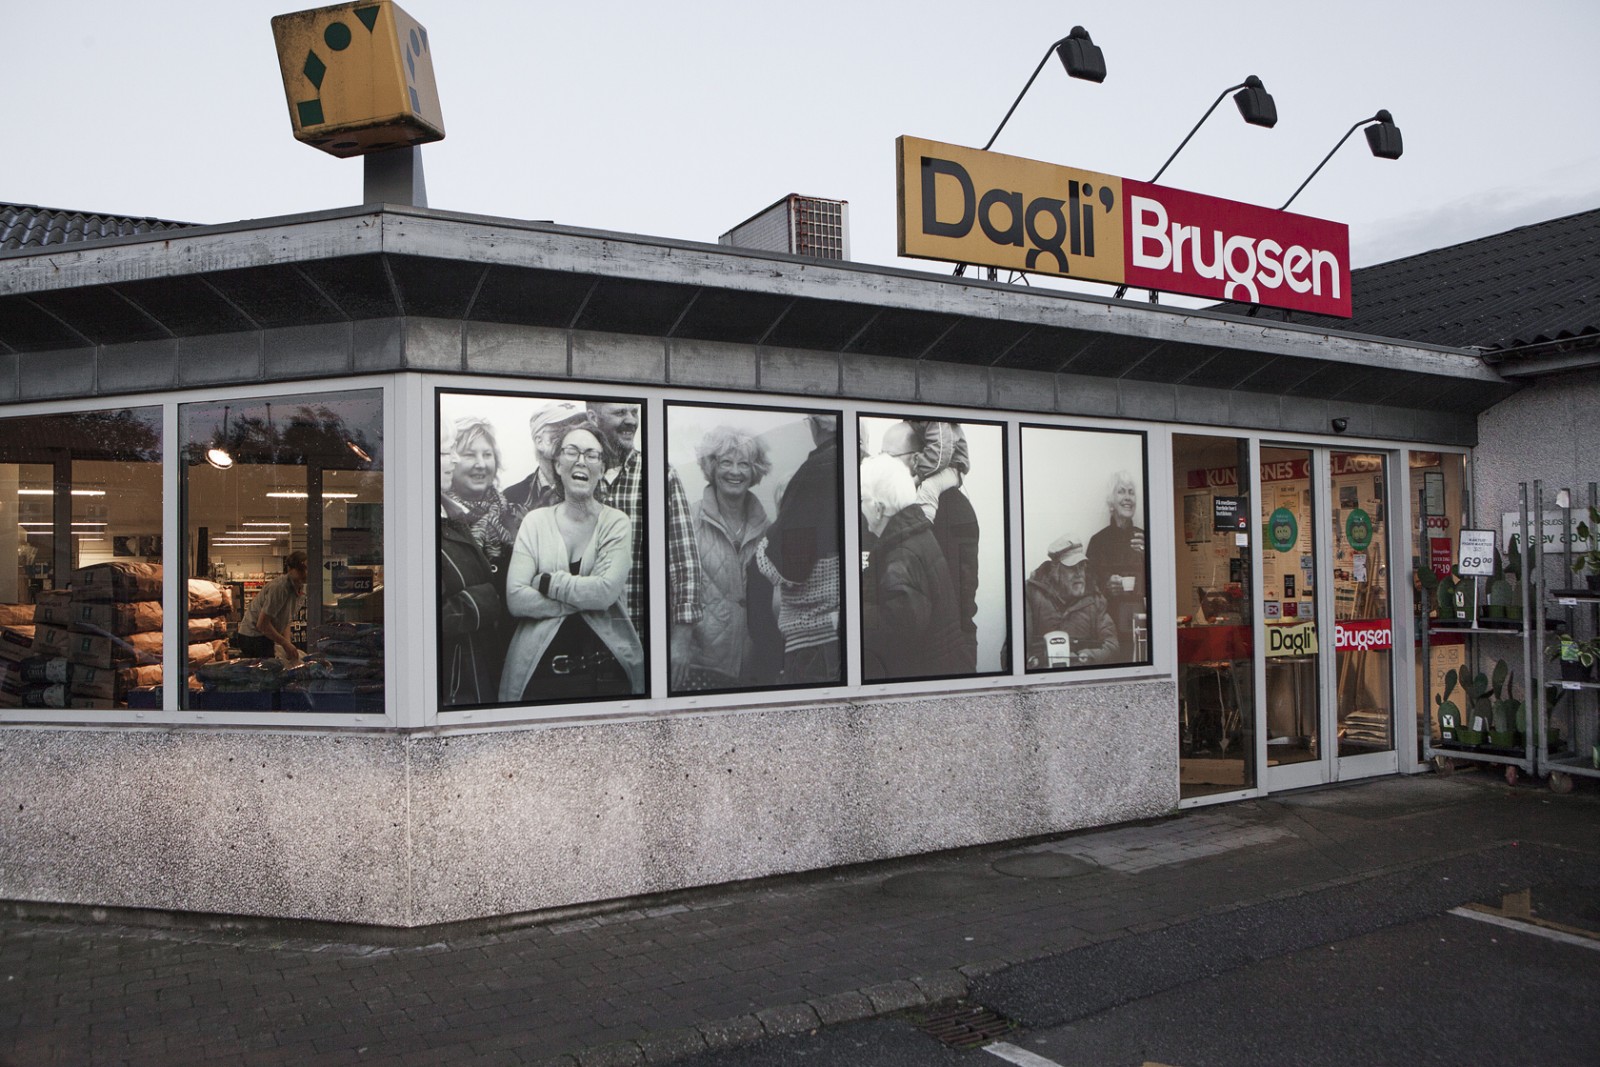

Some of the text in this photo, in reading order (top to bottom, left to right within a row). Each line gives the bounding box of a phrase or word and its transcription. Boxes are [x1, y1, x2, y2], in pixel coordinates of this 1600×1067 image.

[921, 156, 1340, 304] Dagli' Brugsen
[1206, 461, 1293, 485] KUNRNES
[1511, 533, 1554, 545] Rsev
[1270, 626, 1391, 655] Dagli' Brugsen
